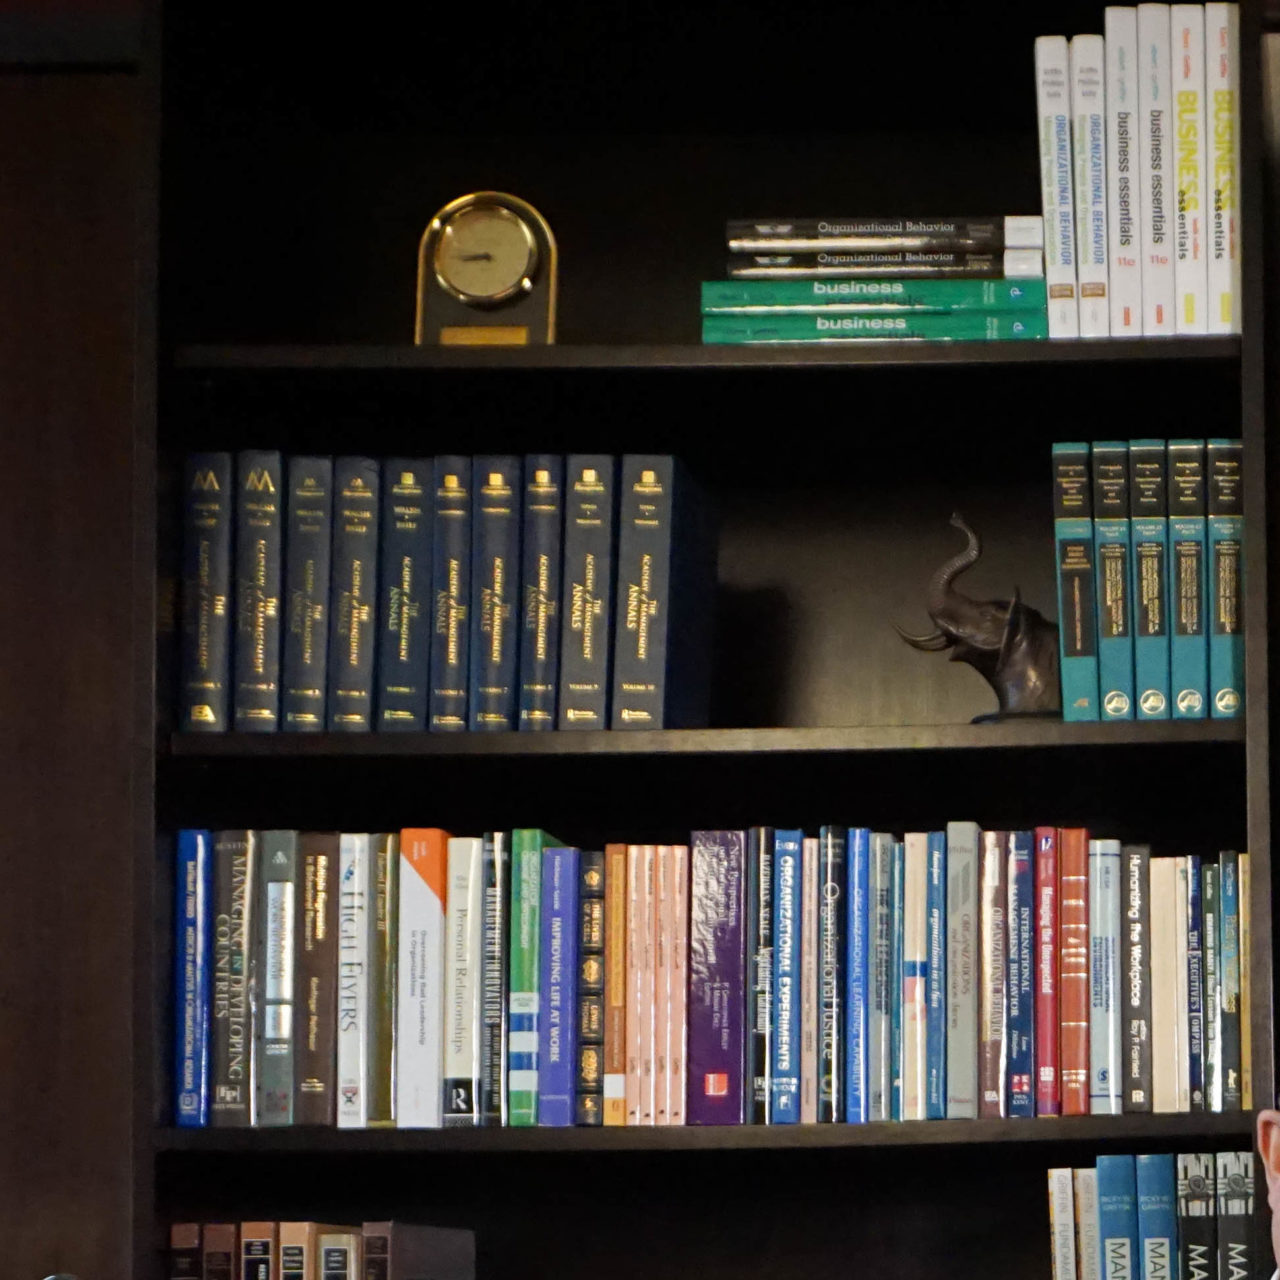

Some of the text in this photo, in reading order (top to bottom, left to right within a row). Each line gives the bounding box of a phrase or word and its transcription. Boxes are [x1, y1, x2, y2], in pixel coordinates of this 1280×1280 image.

[1055, 115, 1072, 264] ORGANIZATIONAL BEHAVIOR
[1089, 114, 1104, 264] ORGANIZATIONAL BEHAVIOR
[1117, 111, 1133, 245] business essentials
[1150, 110, 1165, 244] business essentials
[1177, 90, 1198, 210] BUSINESS
[1213, 90, 1234, 210] BUSINESS
[818, 222, 955, 232] Organizational Behavior
[818, 253, 955, 263] Organizational Behavior
[1177, 190, 1188, 259] essentials
[1214, 189, 1225, 259] essentials
[814, 282, 903, 293] business
[817, 318, 906, 328] business
[627, 584, 639, 629] ANNALS
[641, 554, 650, 591] ACADEMY
[649, 600, 657, 615] THE
[638, 604, 647, 659] MANAGEMENT
[233, 855, 247, 951] MANAGING
[485, 887, 501, 1023] MANAGEMENT INNOVATORS
[1010, 884, 1019, 1016] MANAGEMENT BEHAVIOR
[1021, 907, 1029, 993] INTERNATIONAL
[1041, 887, 1052, 993] Managing the Unexpected
[1129, 854, 1141, 1006] Humanizing the Workplace
[215, 914, 229, 1018] COUNTRIES
[341, 891, 364, 1032] HIGH FLYERS
[453, 908, 468, 1054] Personal Relationships
[550, 917, 561, 1062] IMPROVING LIFE AT WORK
[778, 856, 794, 1070] ORGANIZATIONAL EXPERIMENTS
[821, 882, 840, 1059] Organizational Justice
[852, 889, 862, 1095] ORGANIZATIONAL LEARNING CAPABILITY
[228, 976, 243, 1079] DEVELOPING
